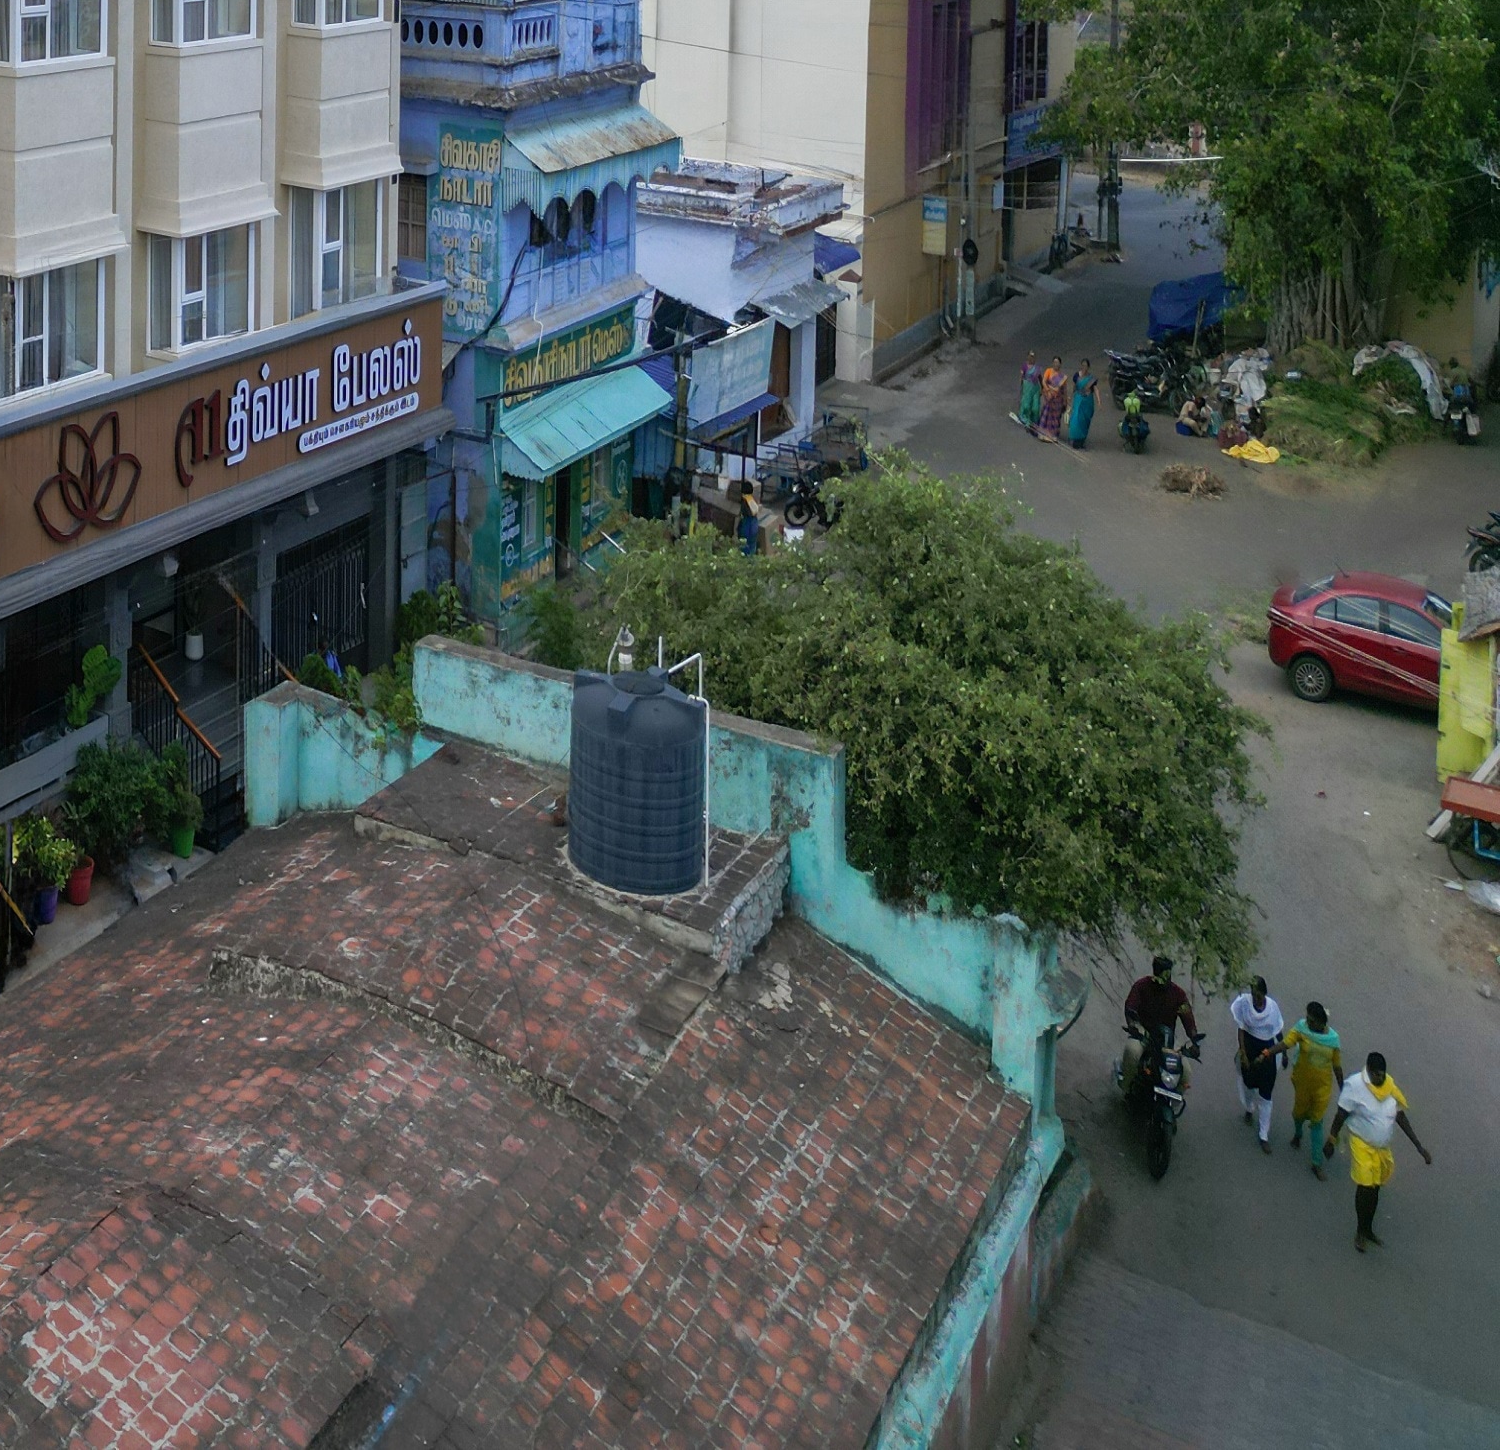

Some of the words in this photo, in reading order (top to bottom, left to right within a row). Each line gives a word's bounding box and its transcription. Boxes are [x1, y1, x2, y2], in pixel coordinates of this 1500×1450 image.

[440, 133, 501, 175] சிவகாசி
[225, 362, 320, 467] திவ்யா
[332, 318, 421, 413] பேலஸ்
